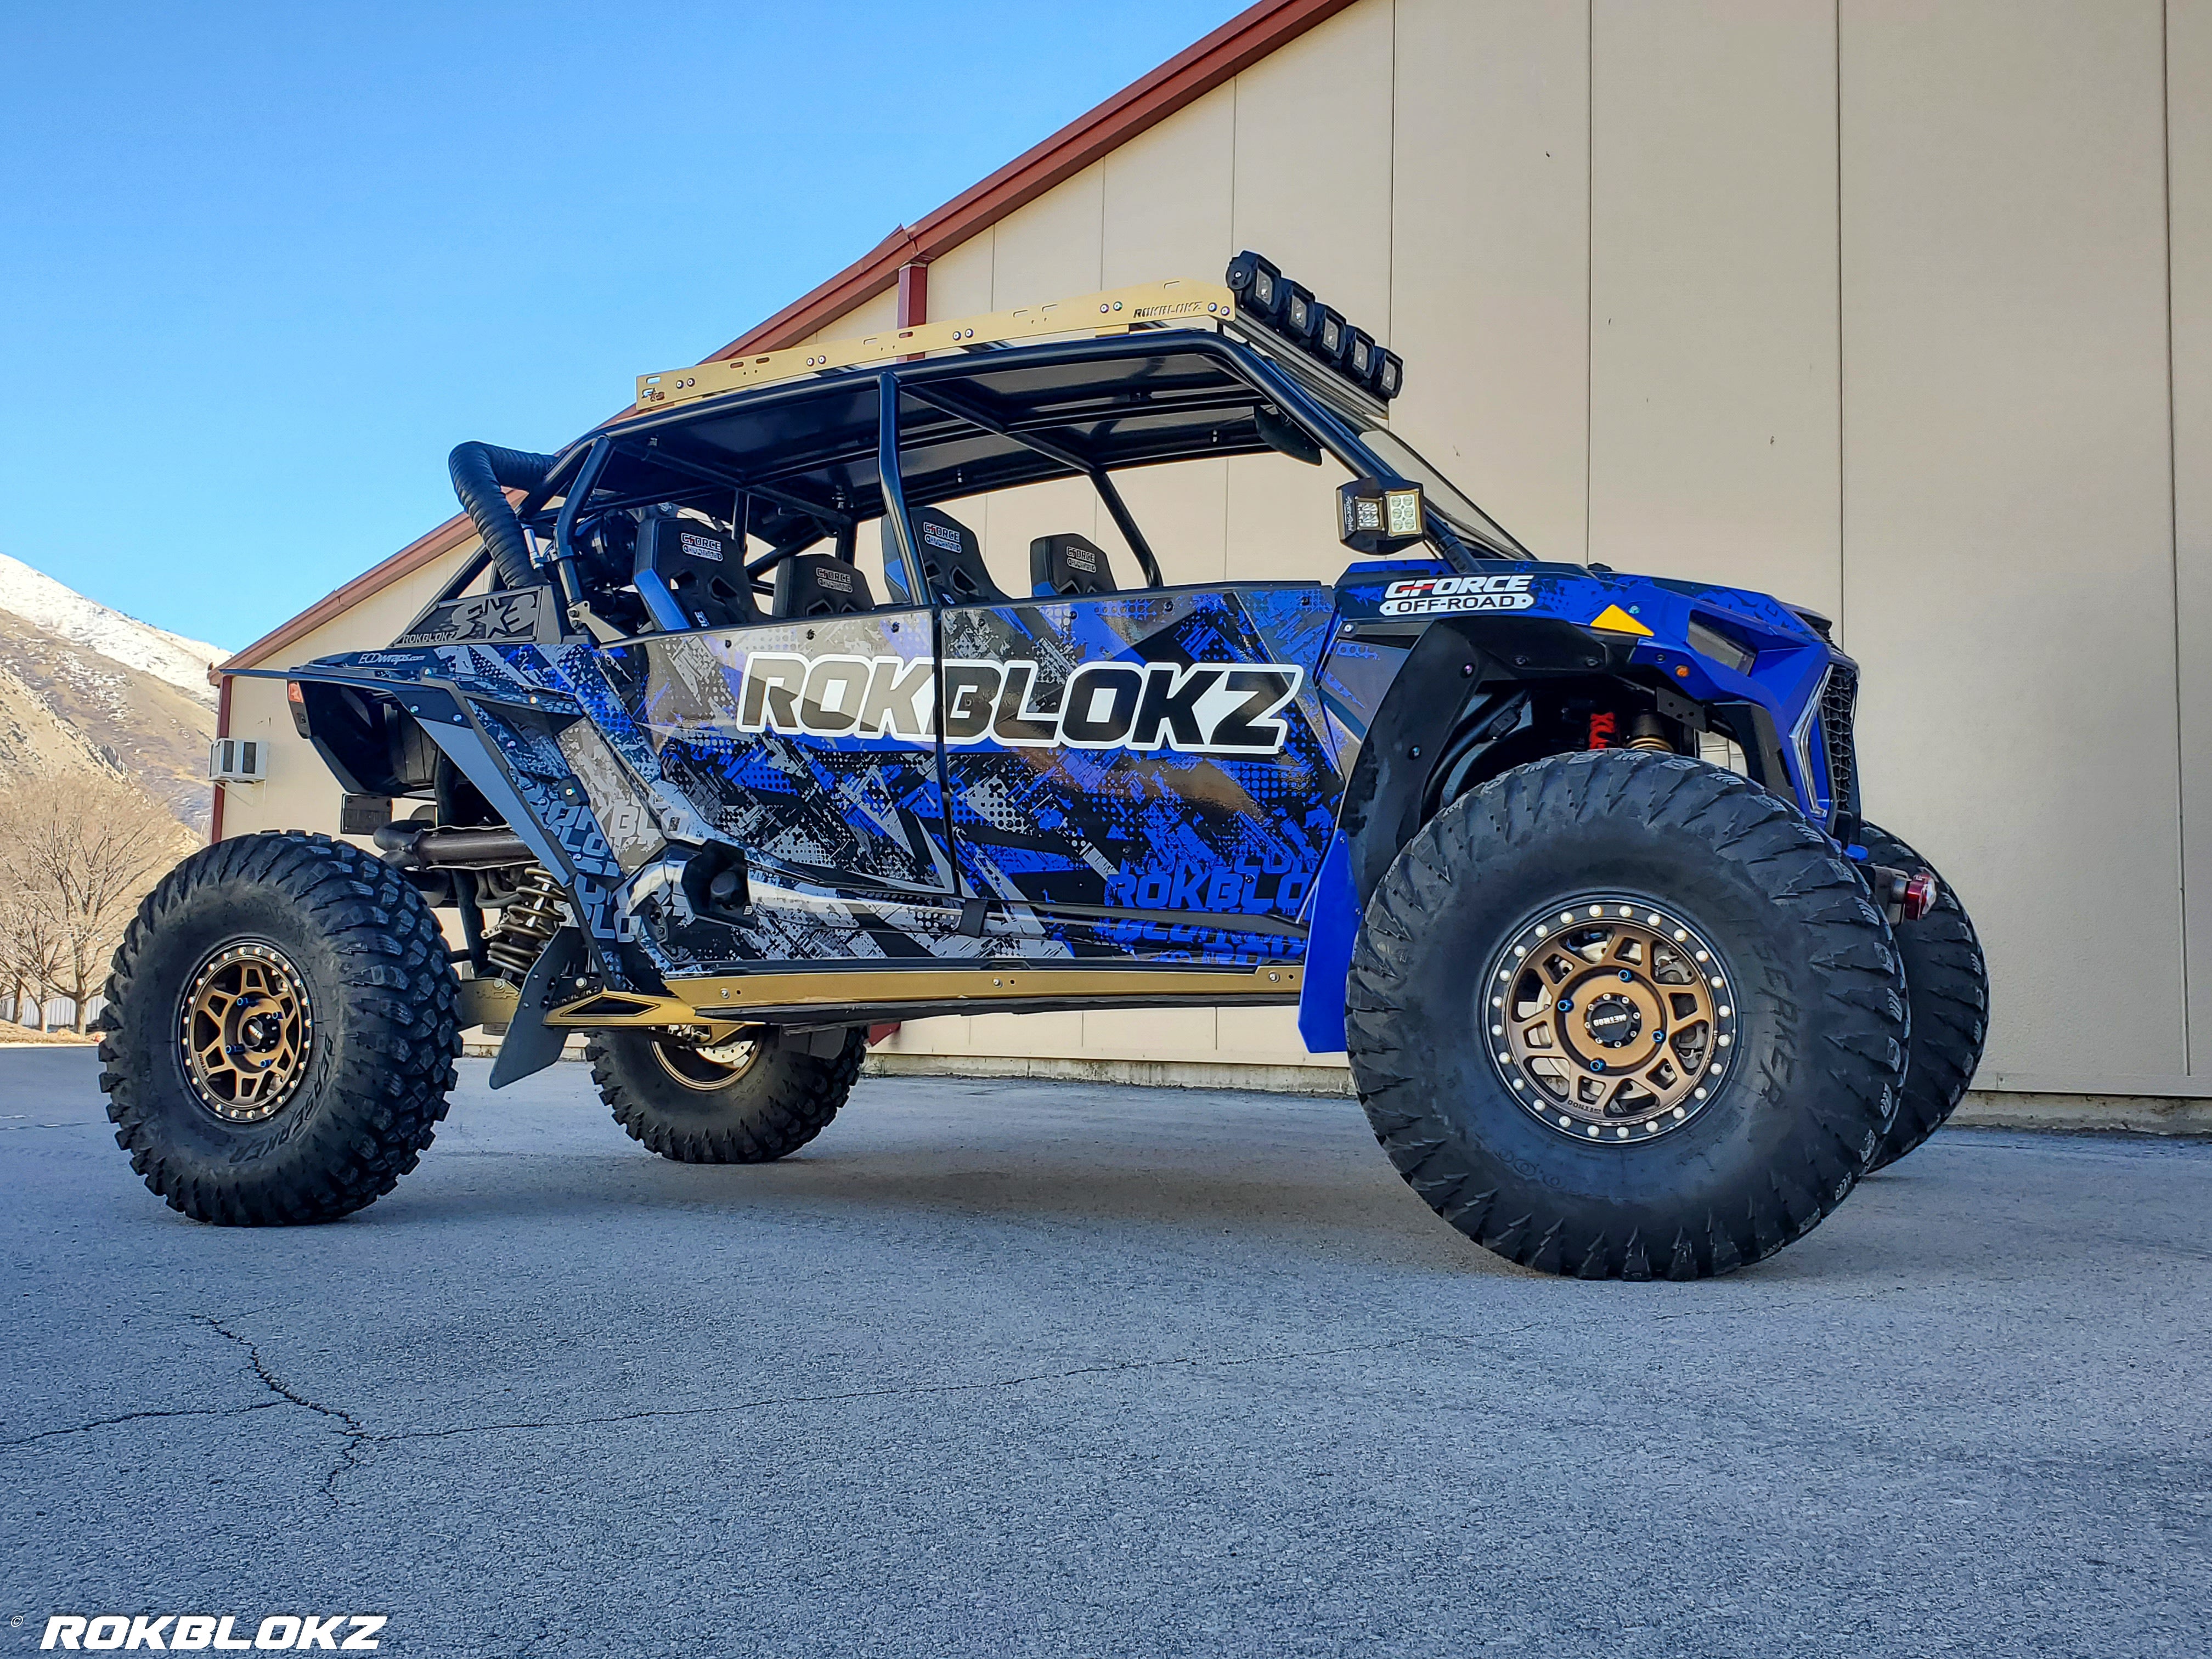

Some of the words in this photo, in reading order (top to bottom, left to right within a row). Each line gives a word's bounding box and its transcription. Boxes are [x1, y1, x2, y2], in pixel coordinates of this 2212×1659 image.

[1385, 575, 1534, 599] GFORCE
[1397, 596, 1515, 613] OFF-ROAD
[403, 631, 457, 644] ROKBLOKZ
[736, 651, 1304, 754] ROKBLOKZ
[1593, 1013, 1627, 1027] METHOD
